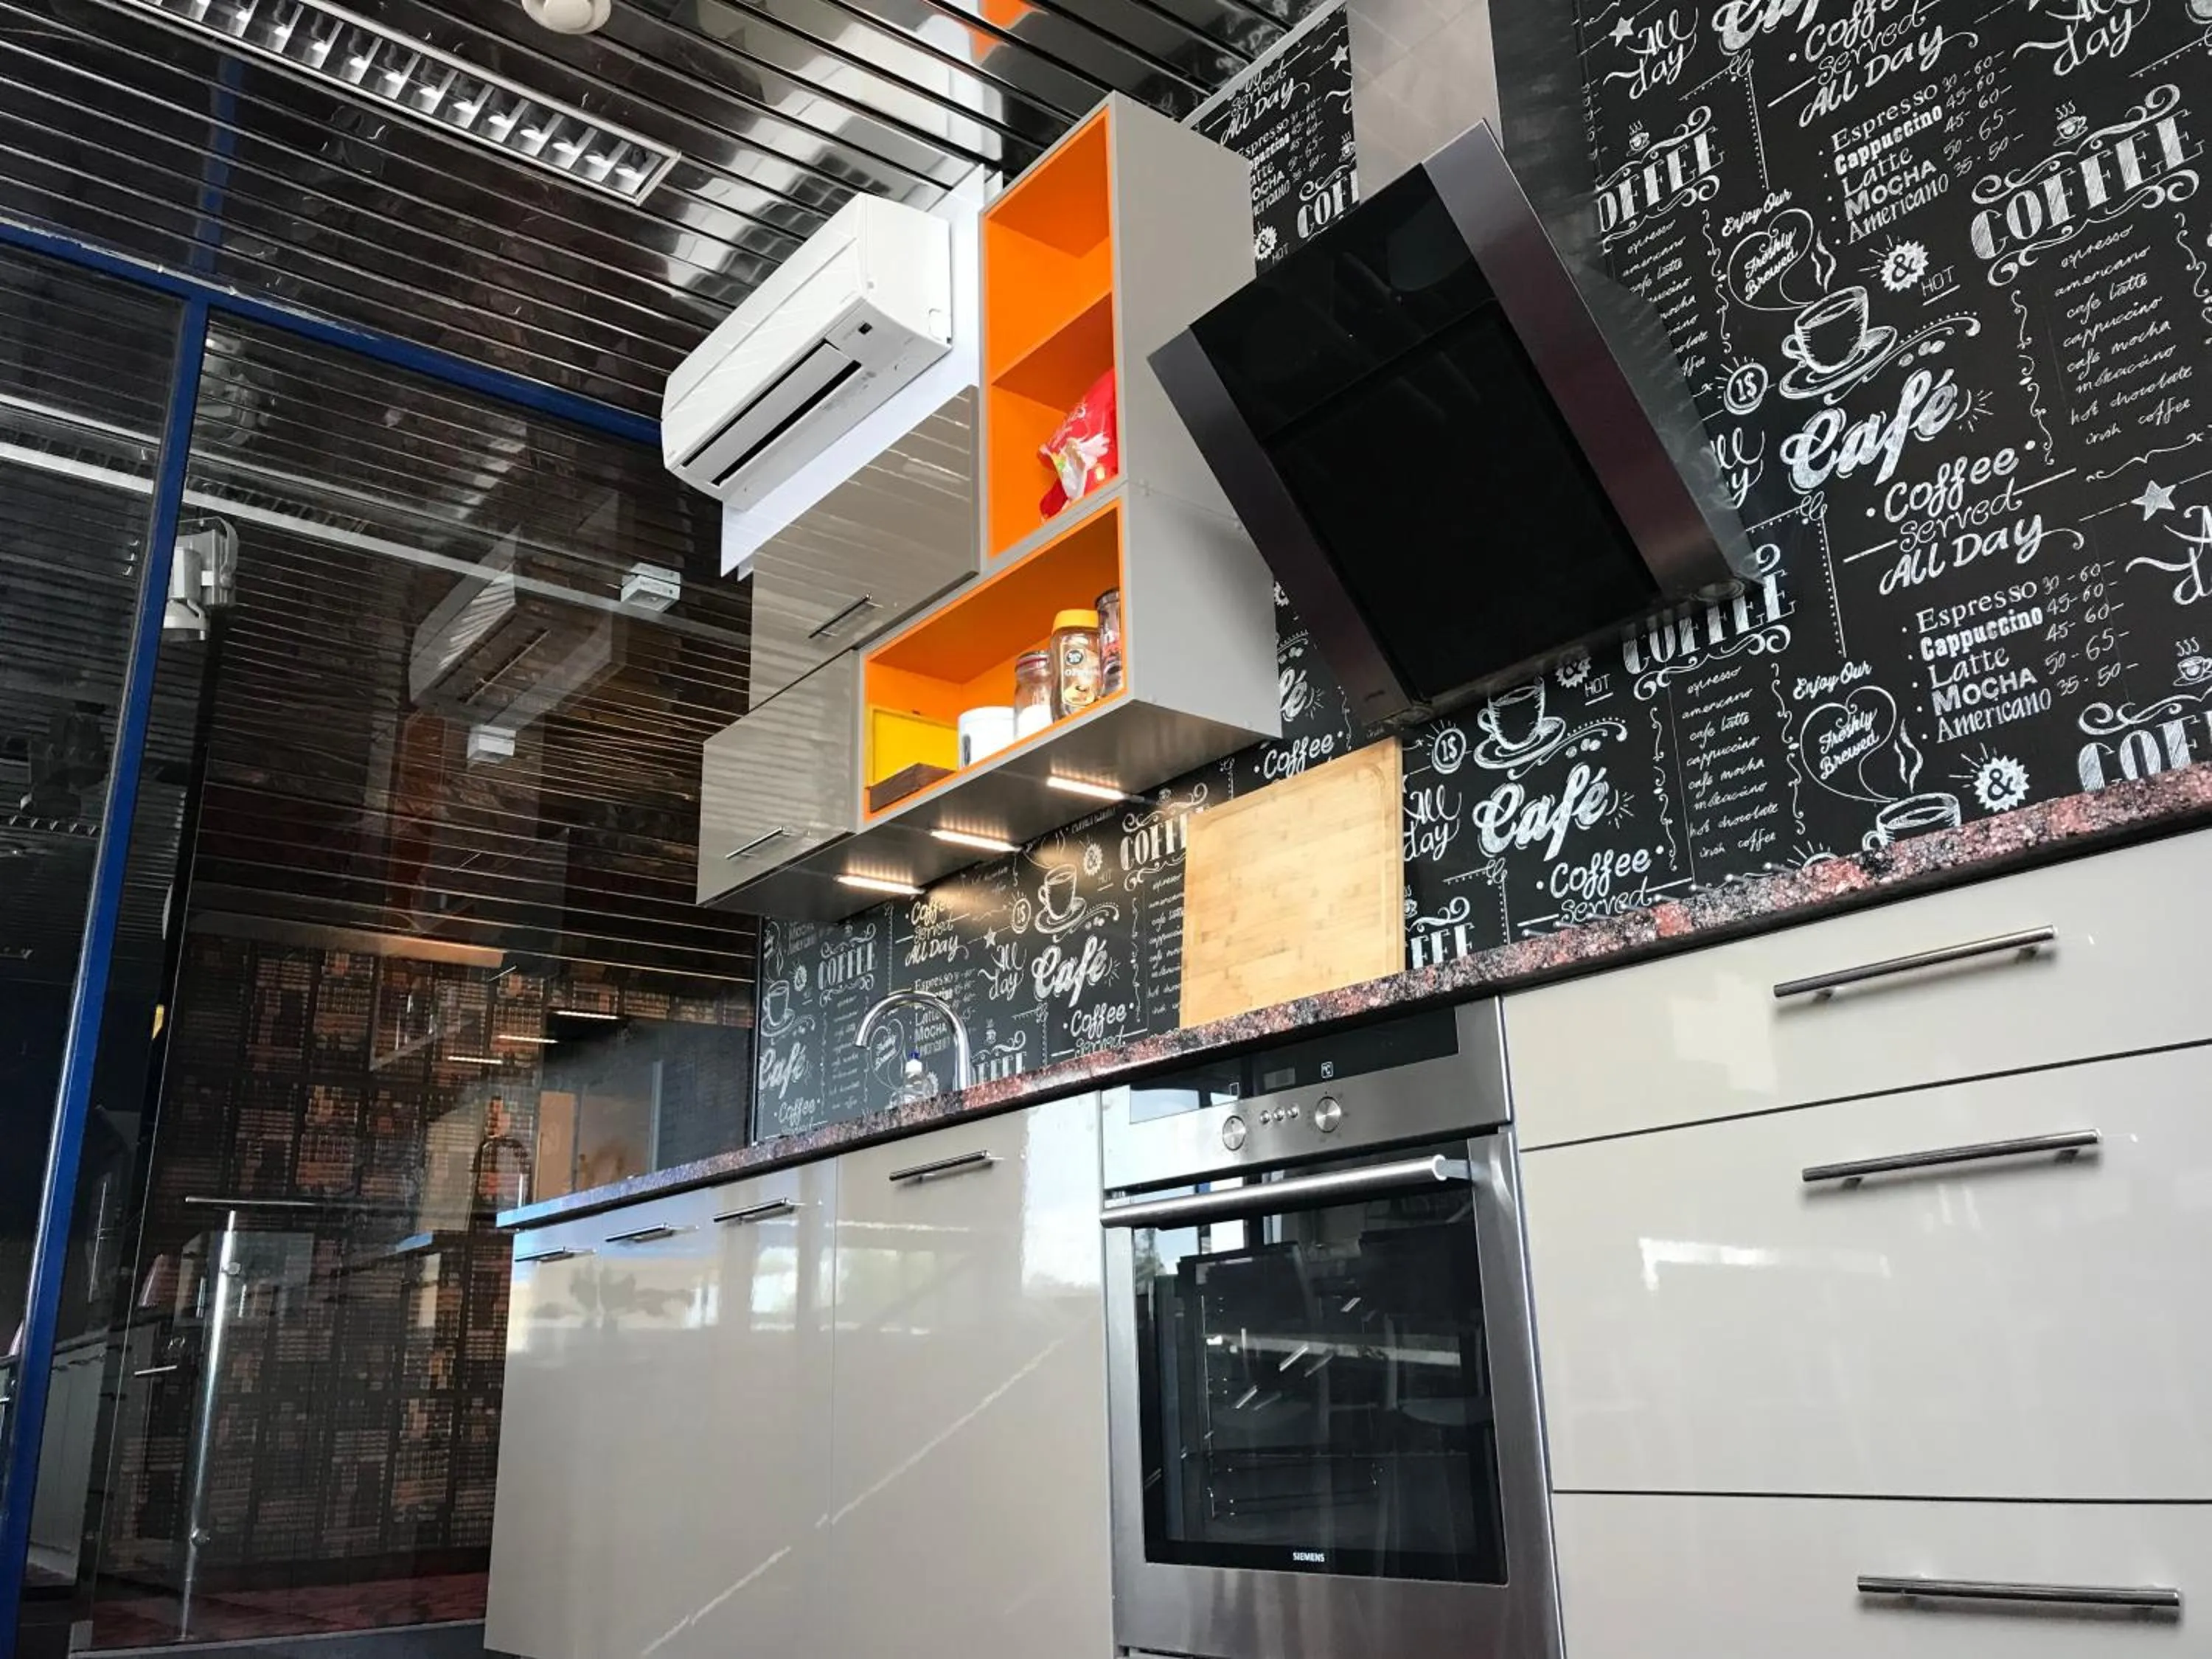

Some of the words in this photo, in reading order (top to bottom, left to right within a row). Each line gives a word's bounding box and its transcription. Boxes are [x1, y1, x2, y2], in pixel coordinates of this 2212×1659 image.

[1627, 10, 1697, 56] All
[1603, 44, 1685, 100] day
[1239, 118, 1290, 158] spresso
[1832, 84, 1938, 152] Espresso
[1834, 105, 1944, 175] Cappuccino
[1253, 170, 1285, 201] OCHA
[1596, 126, 1725, 234] OFFEE
[1842, 147, 1913, 198] Latte
[1970, 109, 2205, 260] COFFEE
[1720, 206, 1764, 237] Enjoy
[1848, 173, 1949, 245] Americano
[1921, 265, 1955, 297] HOT
[2054, 245, 2151, 297] americano
[2063, 296, 2163, 349] cappuccino
[2111, 320, 2171, 354] mocha
[1779, 367, 1961, 493] Café
[2138, 396, 2191, 426] coffee
[1711, 427, 1765, 470] ll
[1883, 448, 2020, 523] Coffee
[1916, 580, 2038, 633] Espresso
[1919, 606, 2044, 662] Cappuccino
[1584, 674, 1612, 699] HOT
[1792, 675, 1840, 700] Enjoy
[1840, 661, 1873, 685] Our
[1927, 646, 2010, 689] Latte
[1682, 688, 1753, 719] americano
[1936, 689, 2052, 743] Americano
[1686, 735, 1760, 771] cappuccino
[1818, 707, 1879, 755] Freshly
[1820, 728, 1880, 780] Brewed
[1263, 733, 1335, 779] Coffee
[1719, 757, 1765, 782] mocha
[1403, 784, 1462, 824] All
[1472, 761, 1610, 862] Café
[1737, 828, 1776, 852] coffee
[1550, 849, 1652, 899] Coffee
[818, 939, 878, 991] COFFEE
[992, 942, 1027, 972] All
[1032, 934, 1110, 1008] Café
[1071, 1001, 1127, 1038] Coffee
[1293, 1551, 1326, 1562] SIEMENS
